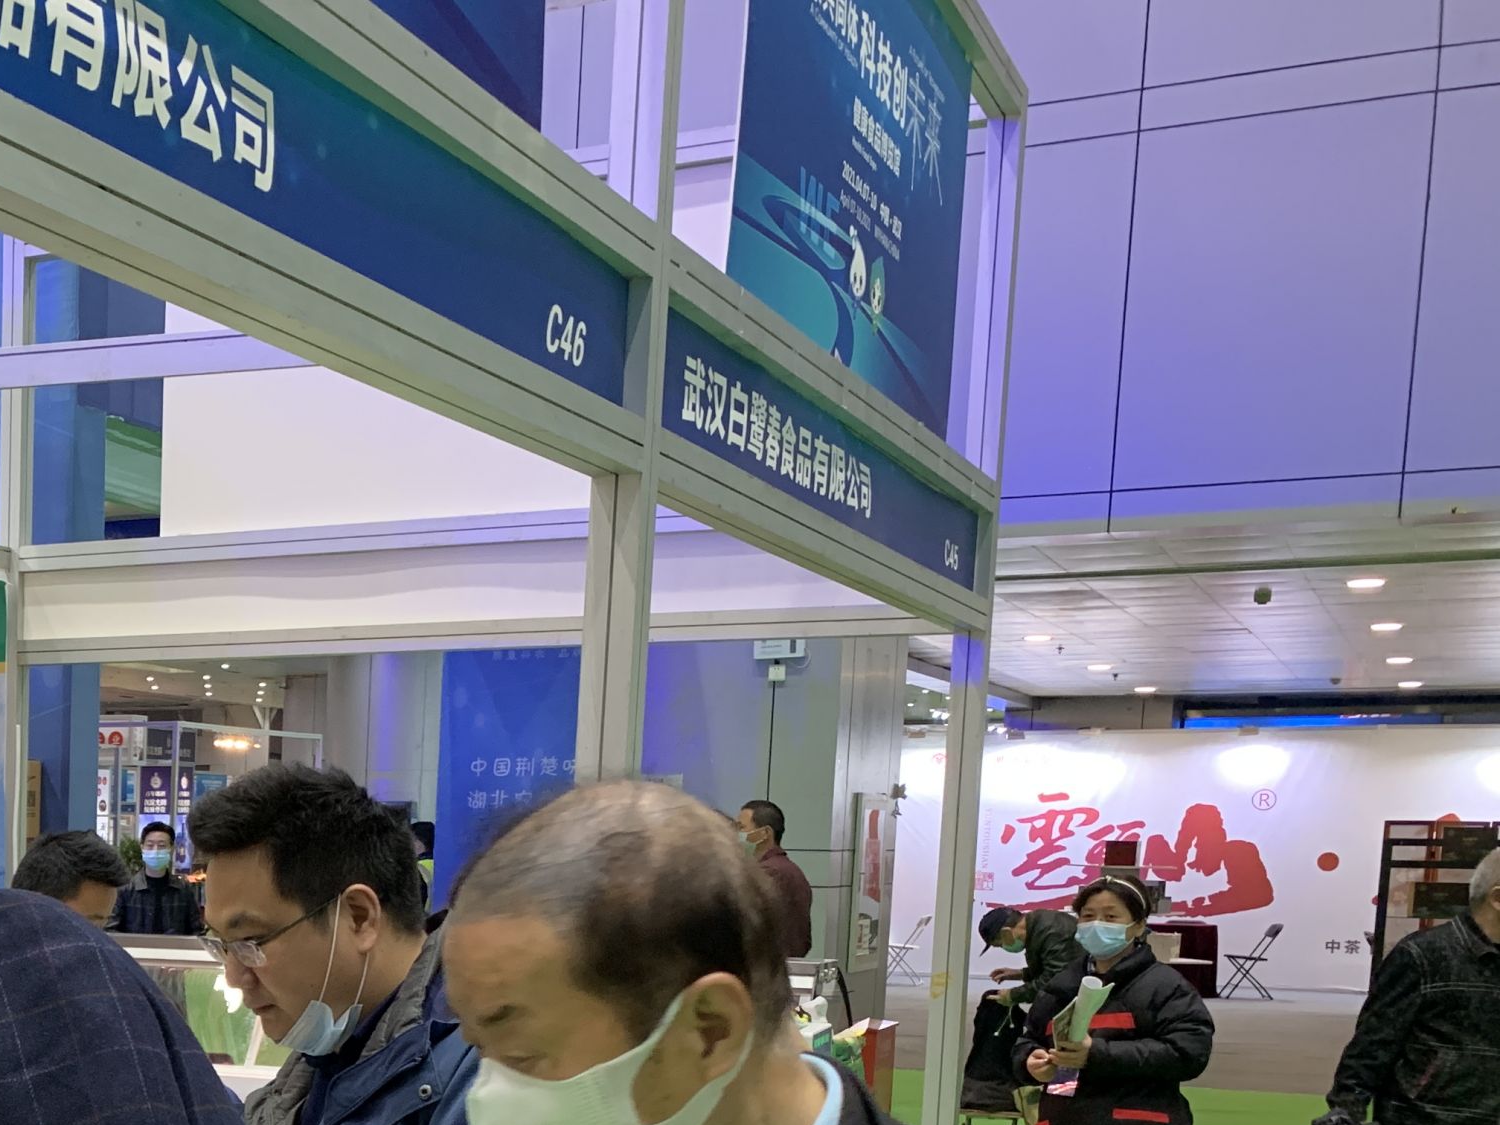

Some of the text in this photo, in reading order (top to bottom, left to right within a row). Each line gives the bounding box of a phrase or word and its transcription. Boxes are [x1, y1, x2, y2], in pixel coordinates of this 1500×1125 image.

[546, 304, 586, 367] C46
[681, 355, 873, 519] 武汉白鹭春食品有限公司
[944, 538, 969, 571] C45
[1325, 939, 1361, 954] 中茶
